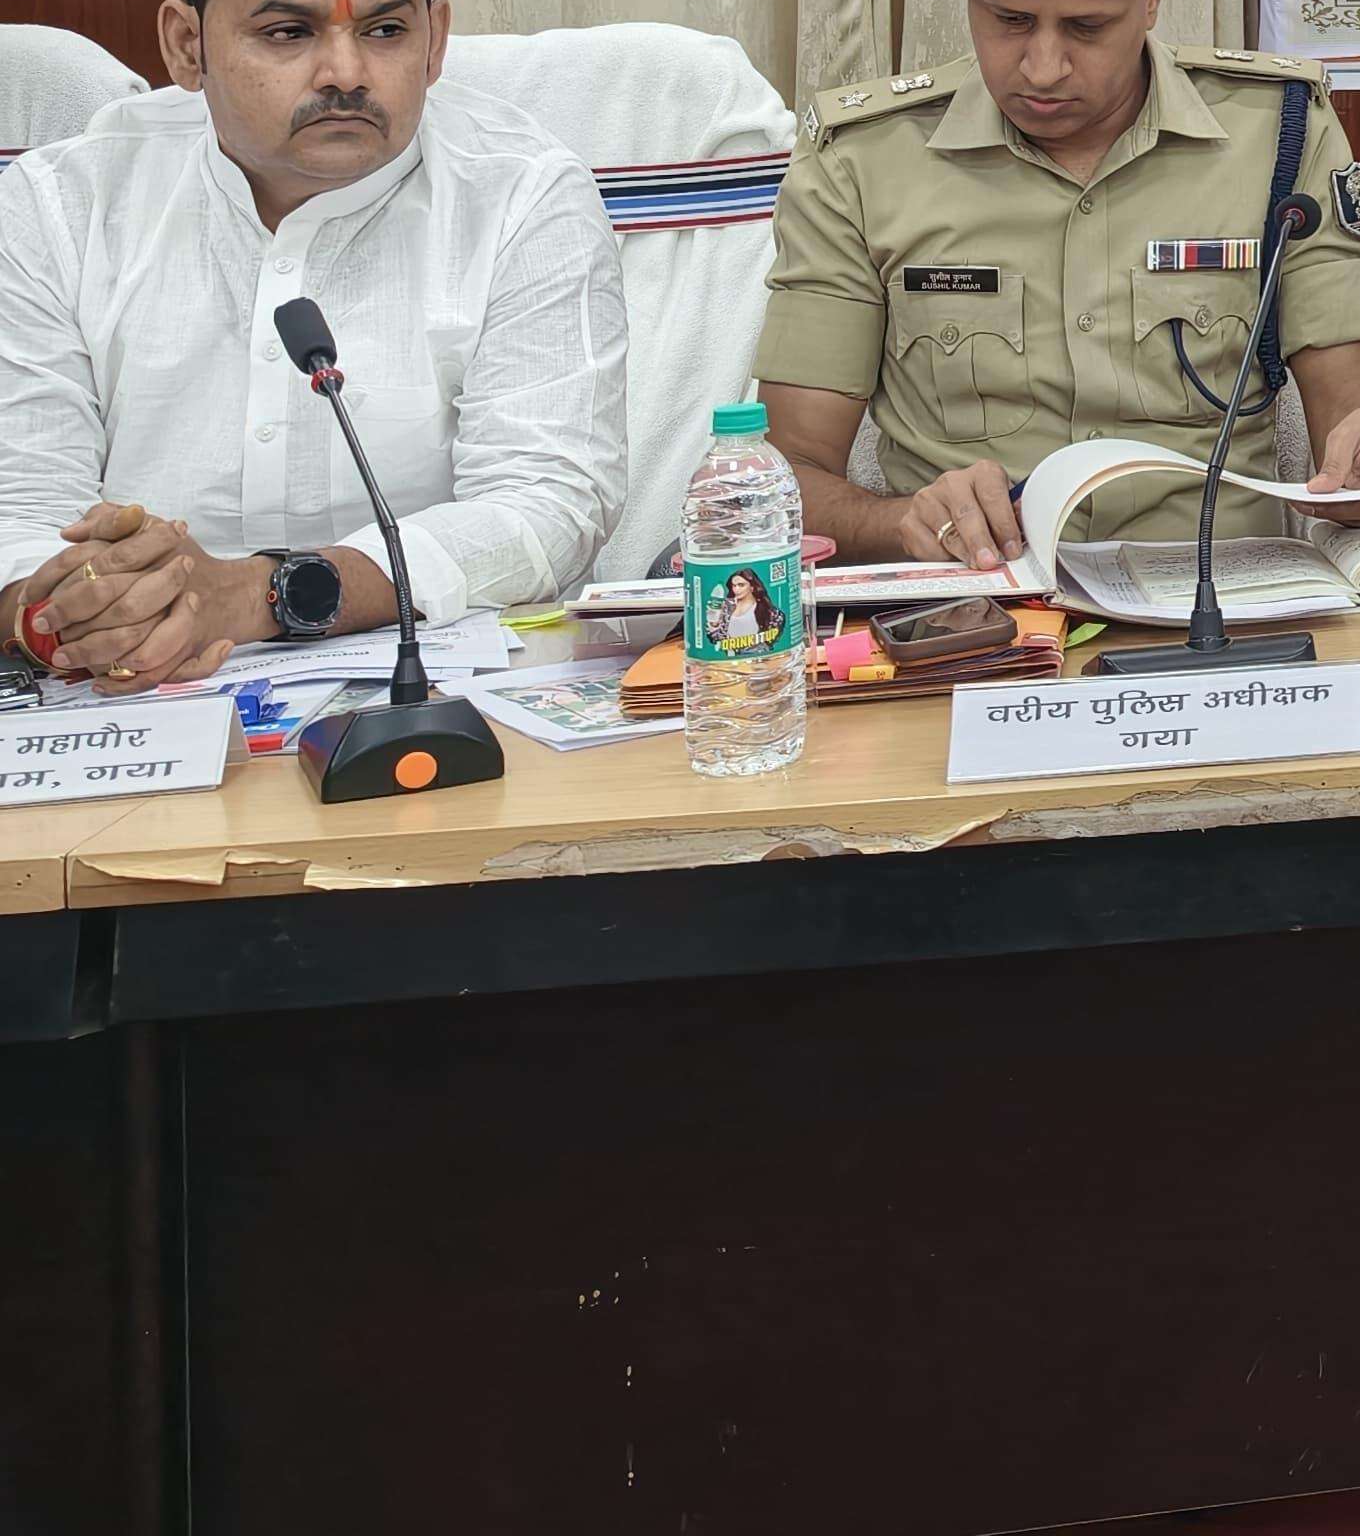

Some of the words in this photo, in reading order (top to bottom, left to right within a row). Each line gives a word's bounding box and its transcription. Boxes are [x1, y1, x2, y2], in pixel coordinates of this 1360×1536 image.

[921, 282, 951, 290] SUSHIL
[986, 696, 1079, 724] वरीय
[1089, 690, 1192, 725] पुलिस
[1203, 681, 1334, 709] अधीक्षक
[16, 722, 152, 755] महापौर
[1119, 728, 1199, 749] गया
[83, 759, 183, 781] गया
